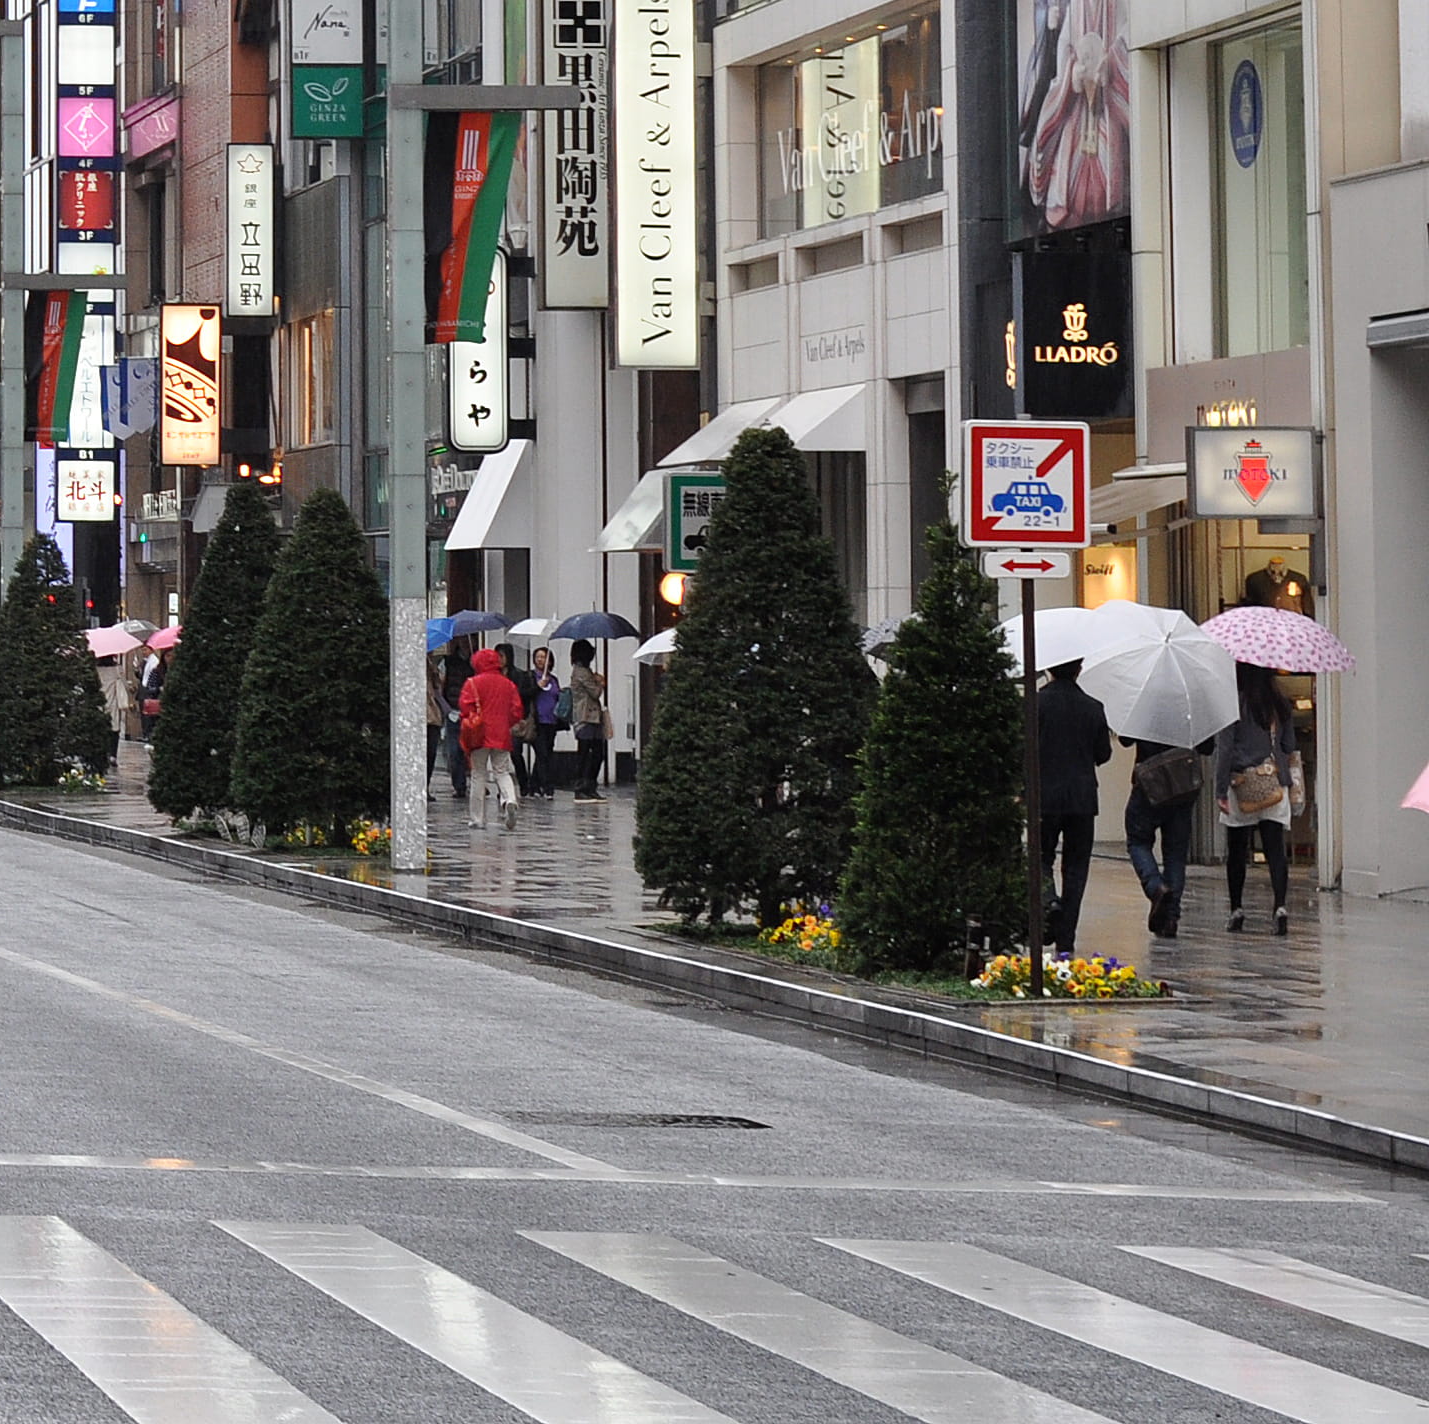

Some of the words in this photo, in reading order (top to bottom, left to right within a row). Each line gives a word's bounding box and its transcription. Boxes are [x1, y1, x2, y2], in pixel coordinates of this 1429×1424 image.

[646, 122, 671, 146] &
[244, 182, 258, 209] 銀座
[639, 158, 673, 261] Cleef
[641, 278, 673, 348] Van
[1034, 341, 1118, 366] LLADRÓ
[985, 442, 1034, 454] タクシー
[985, 456, 1035, 469] 乗車禁止
[65, 481, 106, 501] 北斗
[1015, 495, 1041, 507] TAXI
[1023, 516, 1060, 527] 22-1
